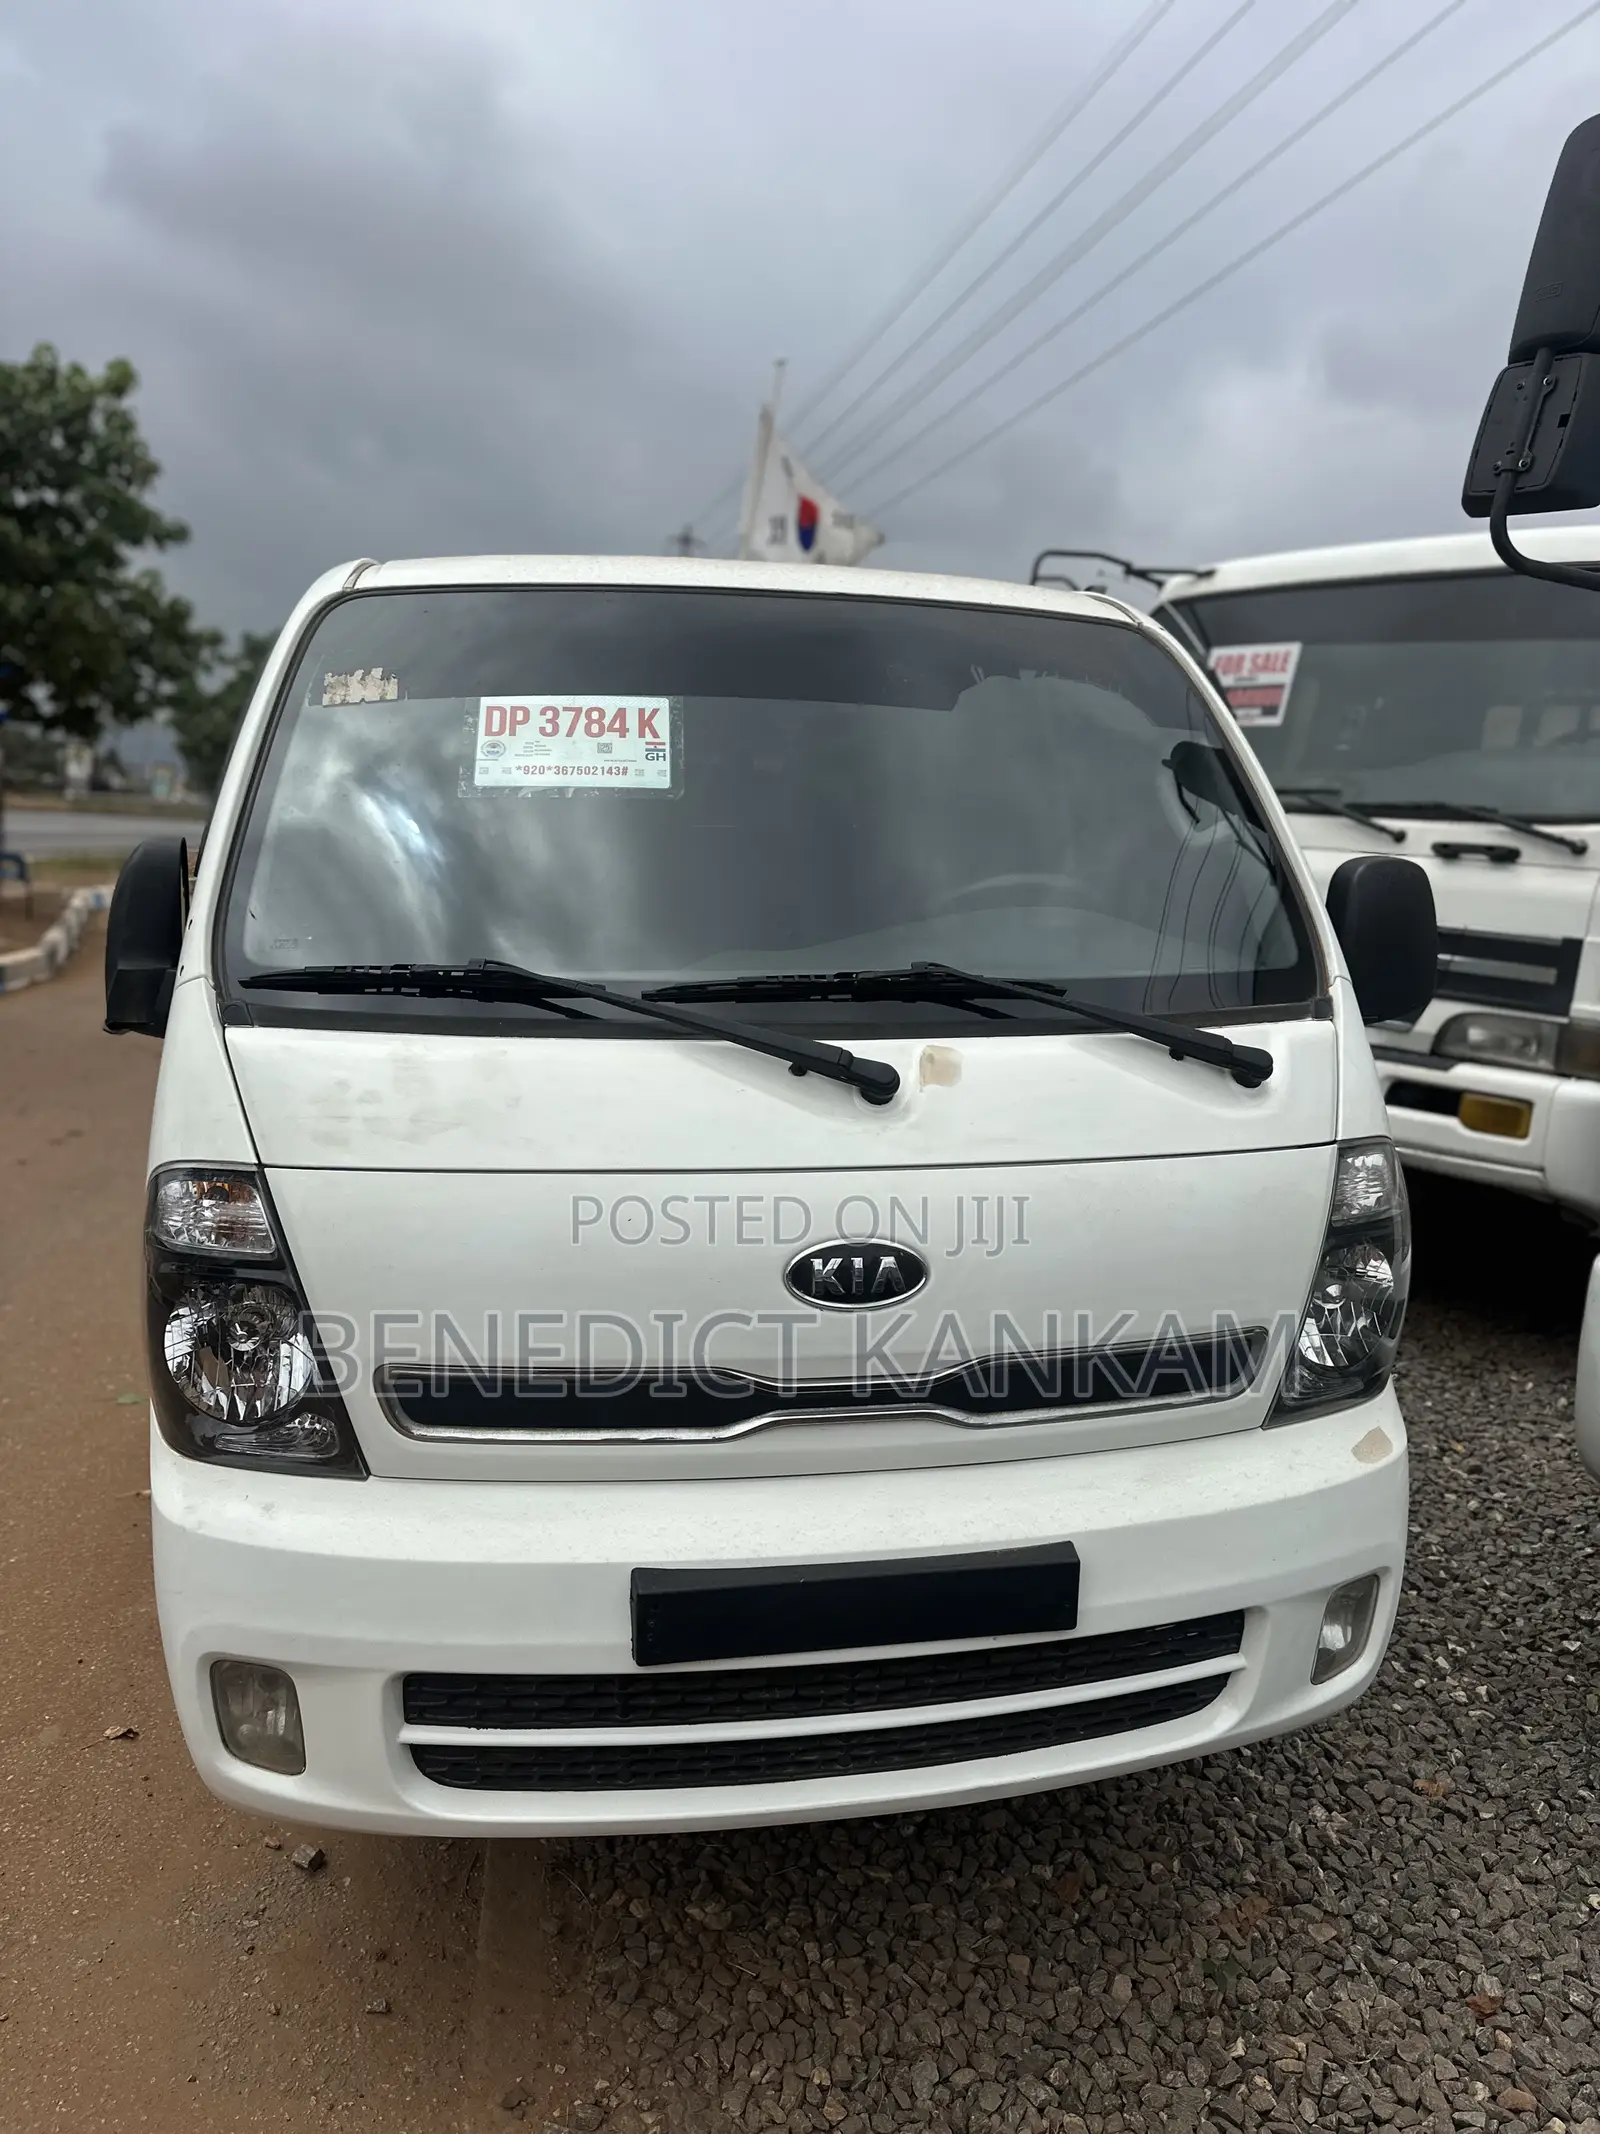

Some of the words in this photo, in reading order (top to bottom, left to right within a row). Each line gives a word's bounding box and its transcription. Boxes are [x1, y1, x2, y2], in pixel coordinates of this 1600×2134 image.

[1250, 650, 1292, 674] SALE
[484, 705, 531, 737] DP
[538, 705, 630, 739] 3784
[637, 707, 661, 739] K
[644, 752, 667, 762] GH
[809, 1255, 908, 1297] KIA
